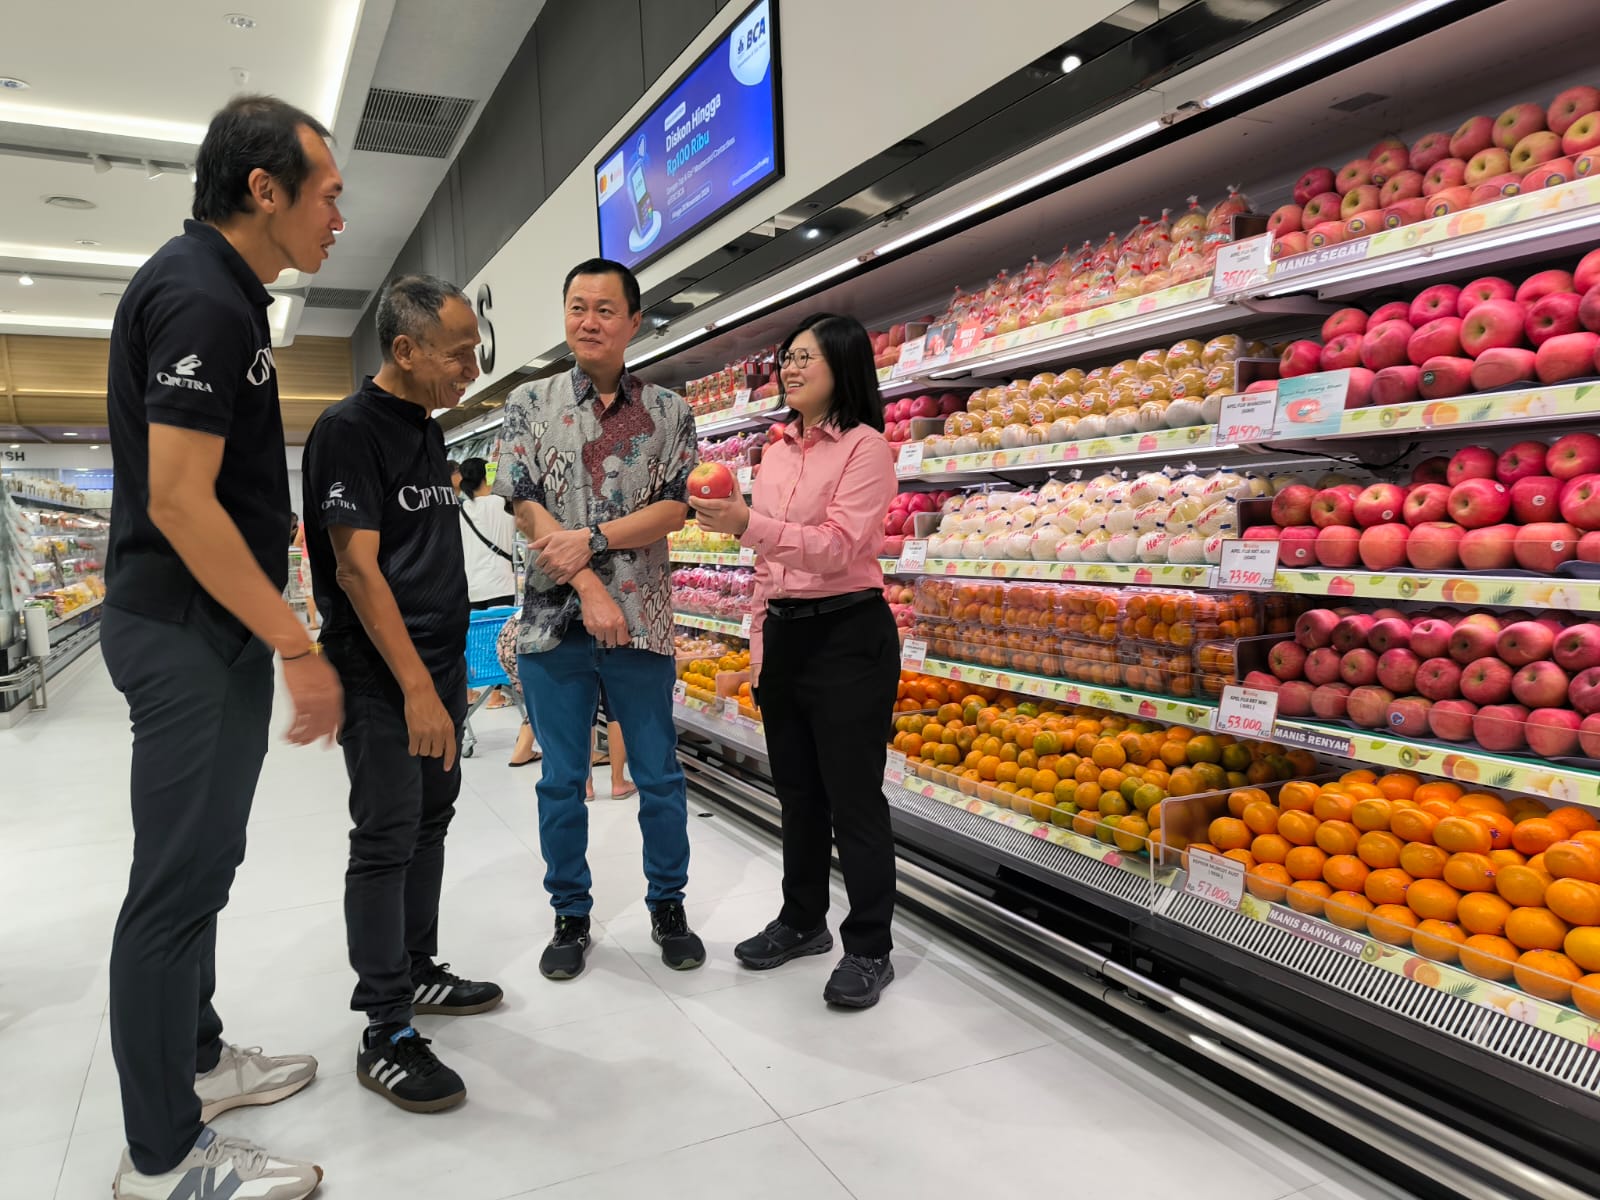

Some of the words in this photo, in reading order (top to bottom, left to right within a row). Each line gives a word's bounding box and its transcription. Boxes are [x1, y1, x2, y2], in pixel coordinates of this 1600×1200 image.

[747, 16, 766, 50] BCA
[666, 120, 692, 152] Diskon
[691, 93, 721, 129] Hingga
[667, 143, 690, 176] Rp100
[690, 130, 710, 158] Ribu
[1276, 254, 1317, 273] MANIS
[1319, 240, 1368, 263] SEGAR
[1273, 728, 1306, 743] MANIS
[1307, 735, 1350, 752] RENYAH
[1268, 909, 1300, 929] MANIS
[1300, 922, 1342, 946] BANYAK
[1342, 940, 1363, 954] AIR
